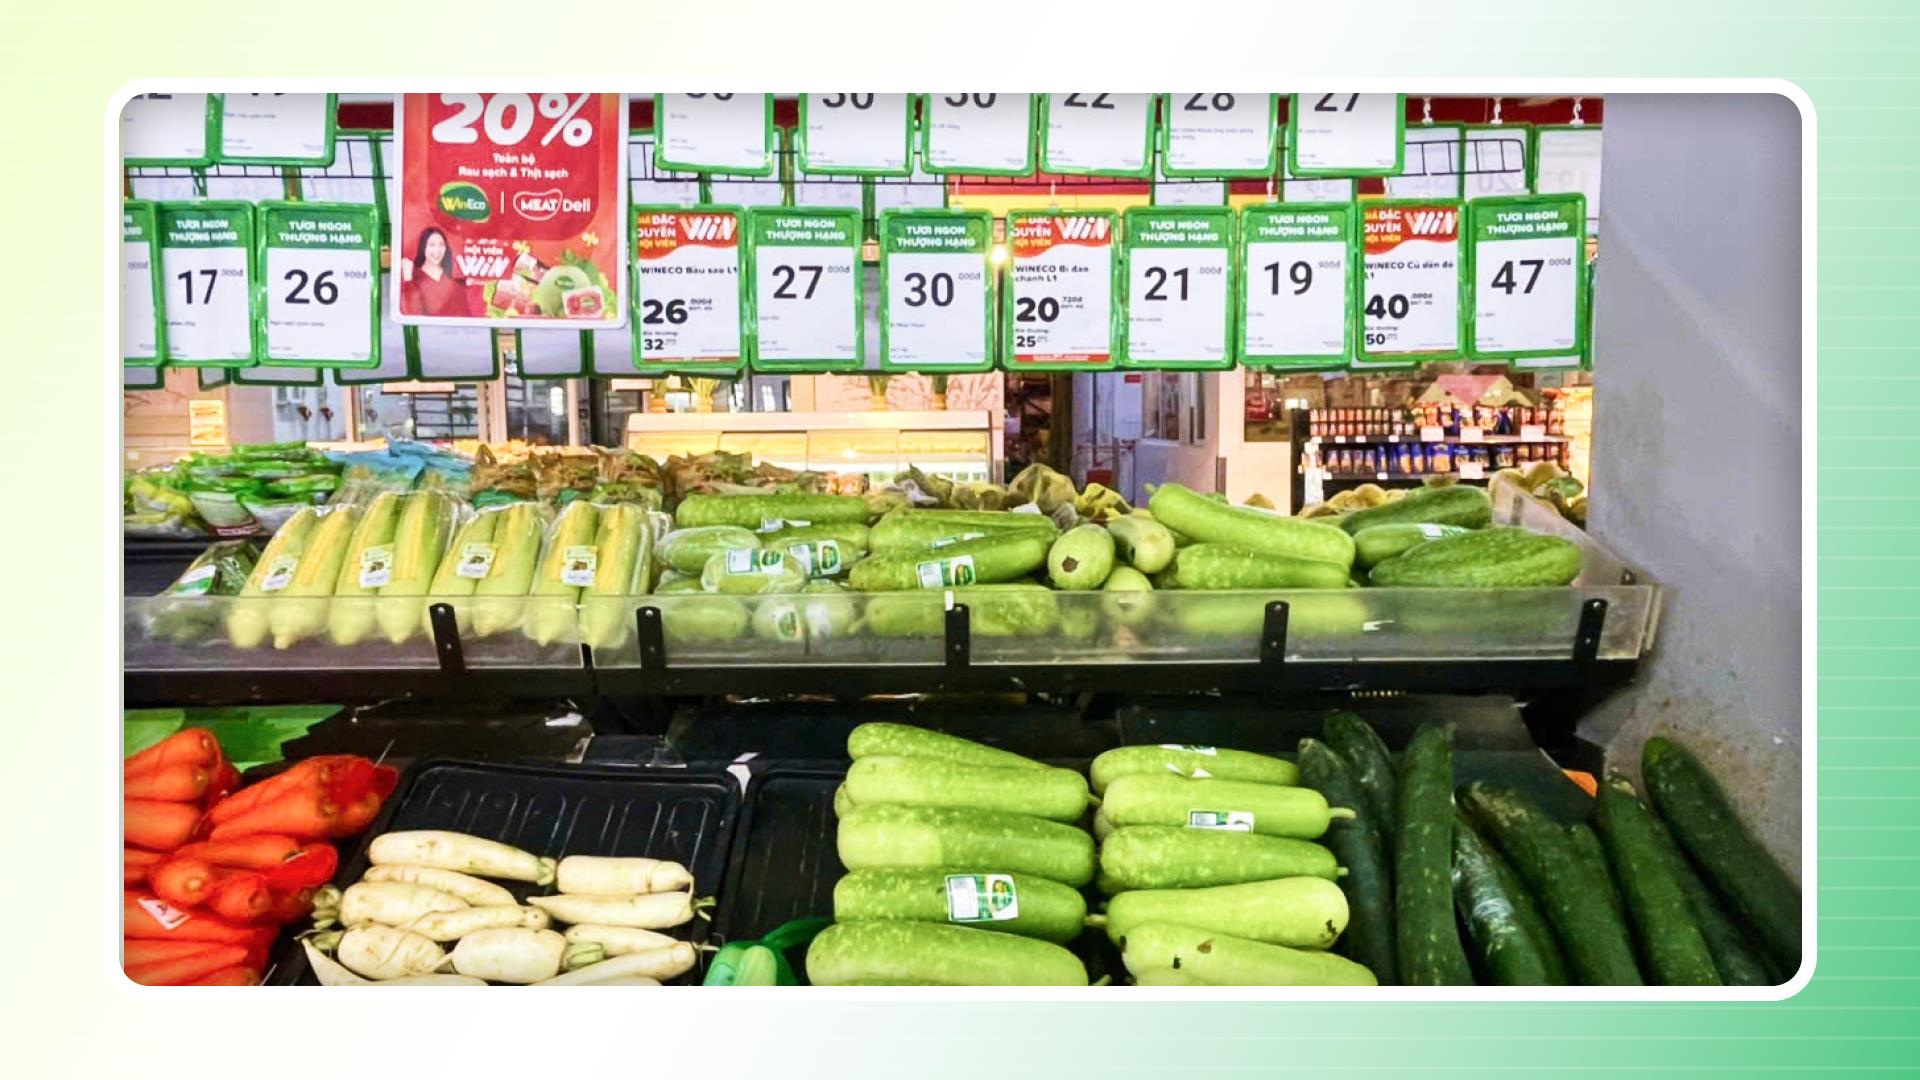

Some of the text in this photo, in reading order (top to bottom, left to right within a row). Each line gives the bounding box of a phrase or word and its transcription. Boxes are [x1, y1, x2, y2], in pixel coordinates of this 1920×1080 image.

[432, 93, 593, 147] 20%
[492, 152, 536, 166] Toàn bộ
[458, 166, 569, 179] Rau sạch & Thịt sạch
[520, 198, 591, 212] MEAT Deli
[1297, 215, 1329, 224] NGON
[1527, 211, 1558, 221] NGON
[202, 220, 228, 228] NGON
[318, 222, 352, 231] NGON
[805, 219, 836, 228] NGON
[1177, 222, 1210, 230] NGON
[1536, 222, 1568, 234] HẠNG
[814, 230, 846, 242] HẠNG
[934, 226, 966, 235] NGON
[1308, 226, 1338, 237] HẠNG
[211, 232, 238, 242] HẠNG
[330, 232, 362, 244] HẠNG
[946, 238, 976, 248] HẠNG
[1188, 232, 1219, 242] HẠNG
[641, 266, 683, 274] WINECO
[772, 265, 823, 300] 27
[1144, 266, 1188, 300] 21
[1264, 260, 1312, 295] 19
[1491, 260, 1545, 295] 47
[178, 269, 218, 304] 17
[284, 269, 338, 305] 26
[904, 272, 954, 307] 30
[643, 299, 688, 324] 26
[1016, 297, 1059, 322] 20
[1365, 294, 1409, 320] 40
[644, 339, 664, 350] 32
[1016, 336, 1036, 347] 25
[1366, 333, 1386, 345] 50
